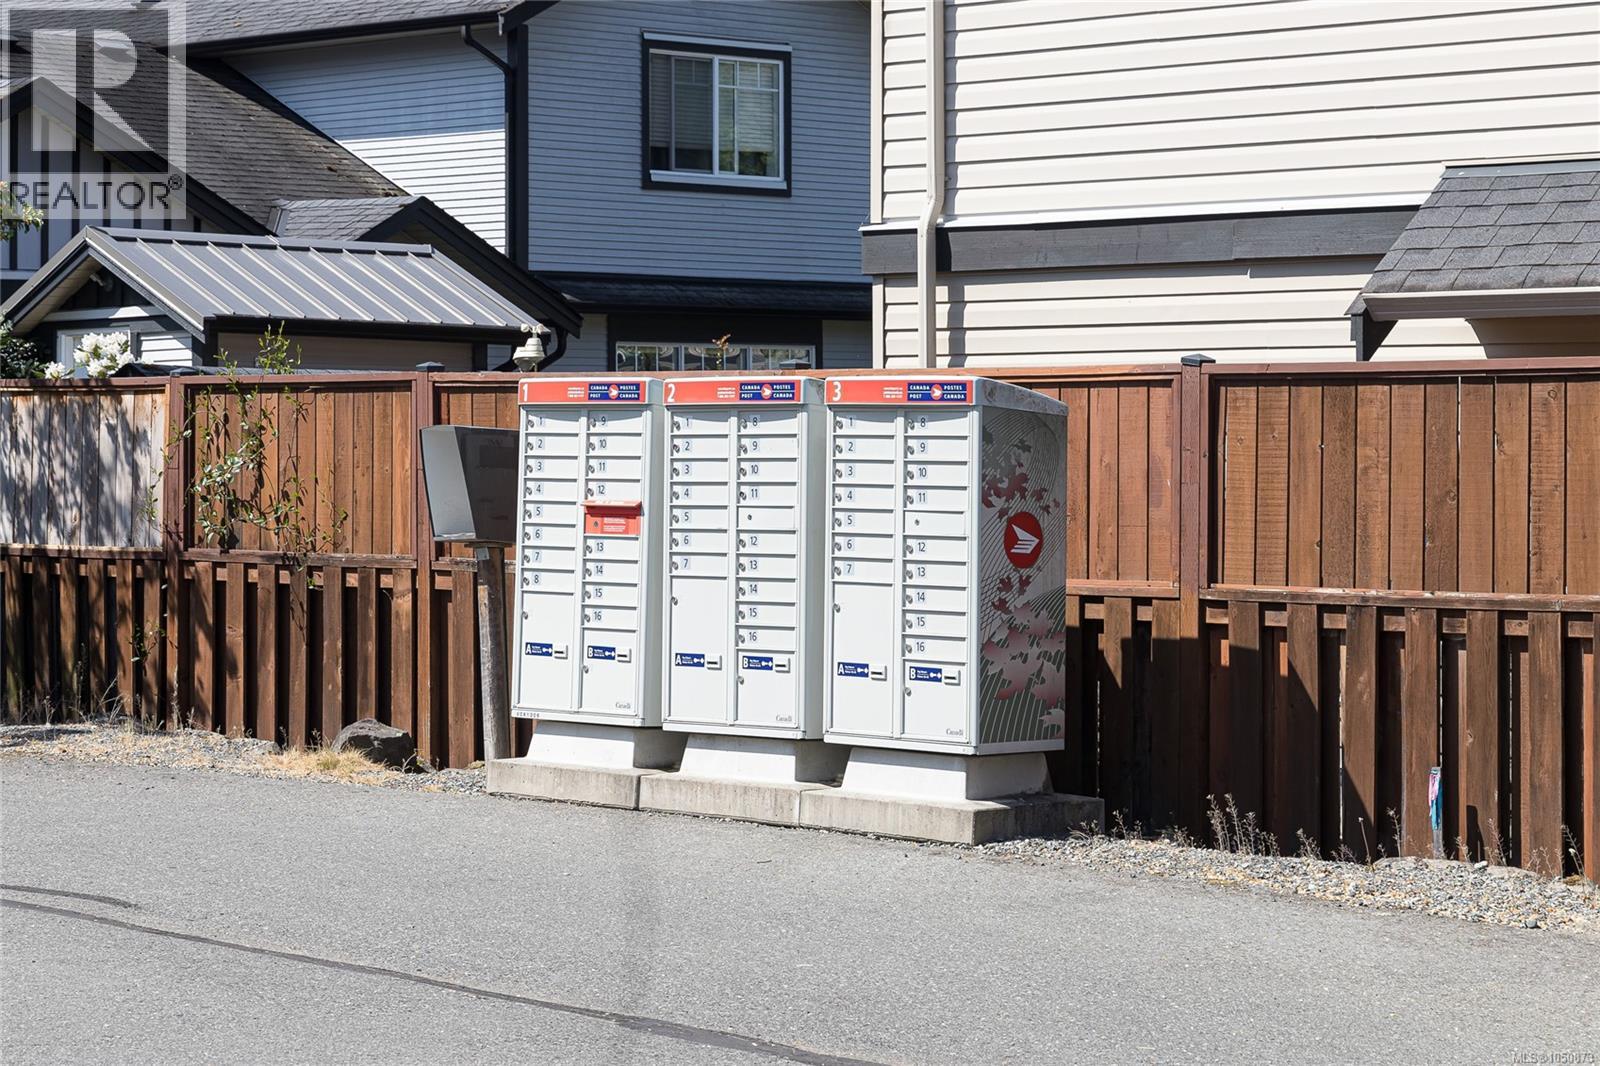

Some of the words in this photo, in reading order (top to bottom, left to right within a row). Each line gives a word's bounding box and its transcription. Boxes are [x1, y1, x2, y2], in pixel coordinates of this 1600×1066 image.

[522, 384, 528, 402] 1
[667, 384, 675, 402] 2
[832, 381, 841, 401] 3
[601, 416, 606, 425] 9
[753, 417, 758, 426] 8
[921, 417, 926, 427] 8
[538, 439, 542, 448] 2
[600, 440, 607, 448] 10
[685, 442, 690, 450] 2
[753, 441, 757, 450] 9
[848, 442, 853, 451] 2
[920, 443, 925, 452] 9
[537, 462, 542, 470] 3
[599, 462, 605, 471] 11
[685, 465, 690, 474] 3
[751, 465, 758, 474] 10
[848, 466, 853, 476] 3
[919, 467, 926, 477] 10
[536, 484, 541, 493] 4
[598, 485, 605, 494] 12
[684, 489, 689, 497] 4
[751, 489, 758, 497] 11
[847, 491, 852, 500] 4
[919, 493, 926, 502] 11
[536, 507, 540, 515] 5
[685, 512, 689, 521] 5
[847, 515, 853, 524] 5
[535, 530, 540, 538] 6
[684, 536, 689, 544] 6
[750, 536, 757, 545] 12
[847, 540, 852, 549] 6
[596, 543, 604, 551] 13
[918, 542, 926, 552] 12
[535, 552, 539, 560] 7
[683, 559, 688, 568] 7
[749, 560, 757, 569] 13
[596, 566, 603, 574] 14
[847, 564, 852, 574] 7
[918, 567, 926, 576] 13
[534, 575, 539, 583] 8
[595, 588, 602, 597] 15
[749, 584, 757, 593] 14
[917, 592, 925, 602] 14
[594, 611, 602, 620] 16
[749, 608, 757, 617] 15
[917, 617, 925, 627] 15
[749, 632, 757, 641] 16
[526, 645, 531, 654] A
[916, 642, 925, 651] 16
[588, 647, 593, 657] B
[676, 655, 682, 665] A
[743, 657, 748, 668] B
[838, 664, 844, 674] A
[910, 668, 916, 679] B
